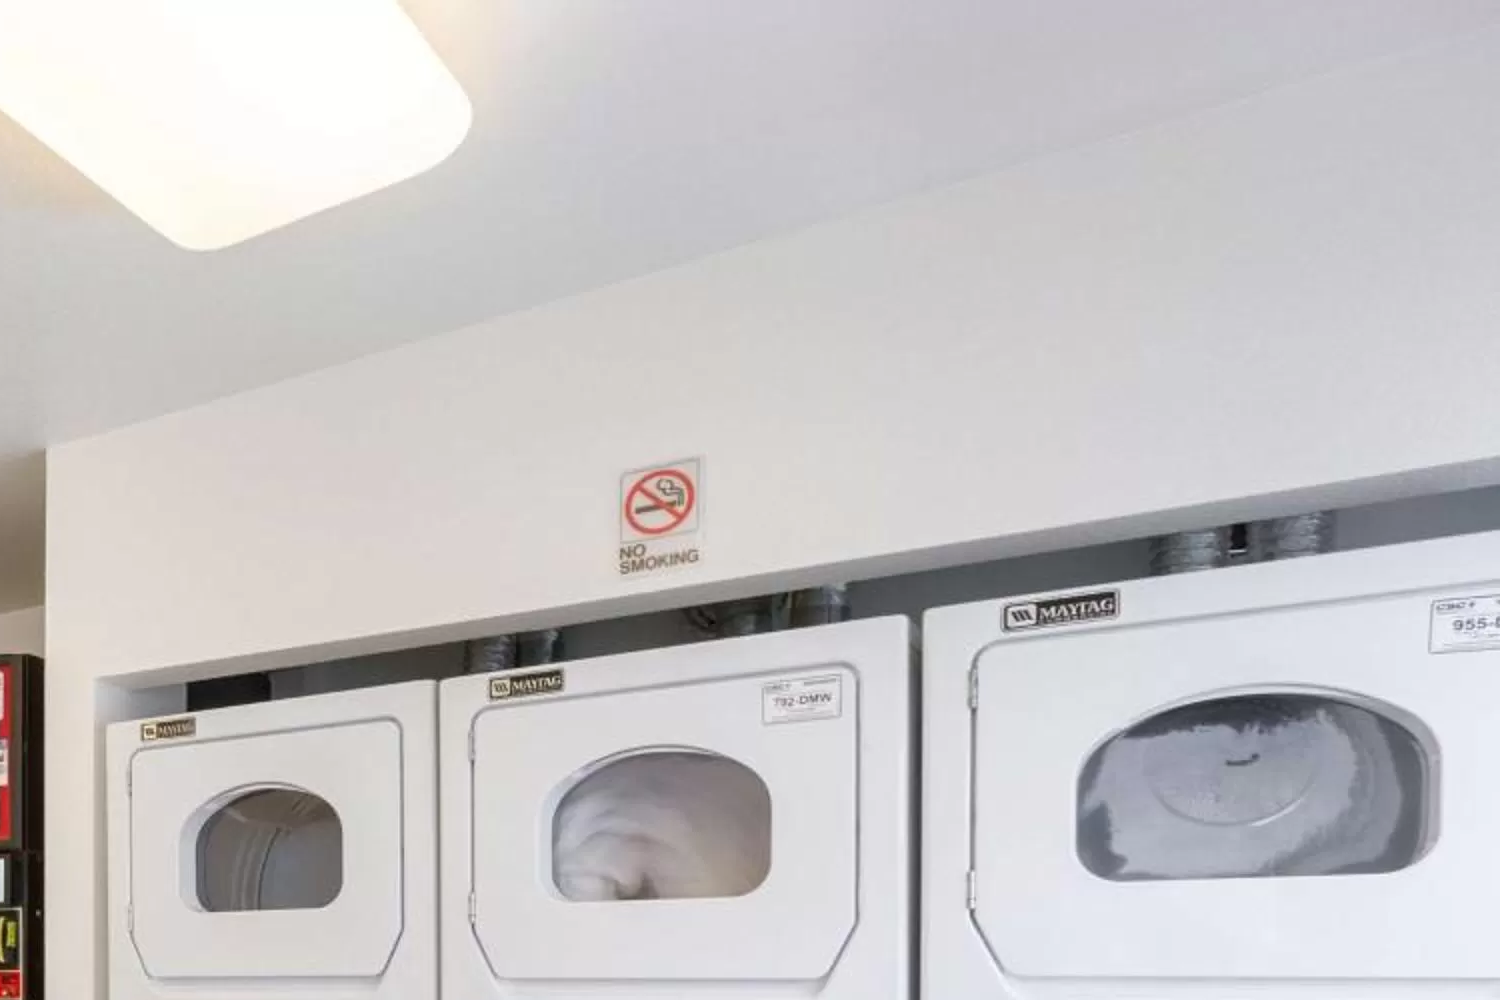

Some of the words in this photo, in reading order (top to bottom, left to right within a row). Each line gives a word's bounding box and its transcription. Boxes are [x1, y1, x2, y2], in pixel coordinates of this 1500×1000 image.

[619, 543, 646, 560] NO
[619, 549, 700, 575] SMOKING
[1040, 597, 1115, 619] MAYTAG
[512, 675, 562, 691] MAYTAG
